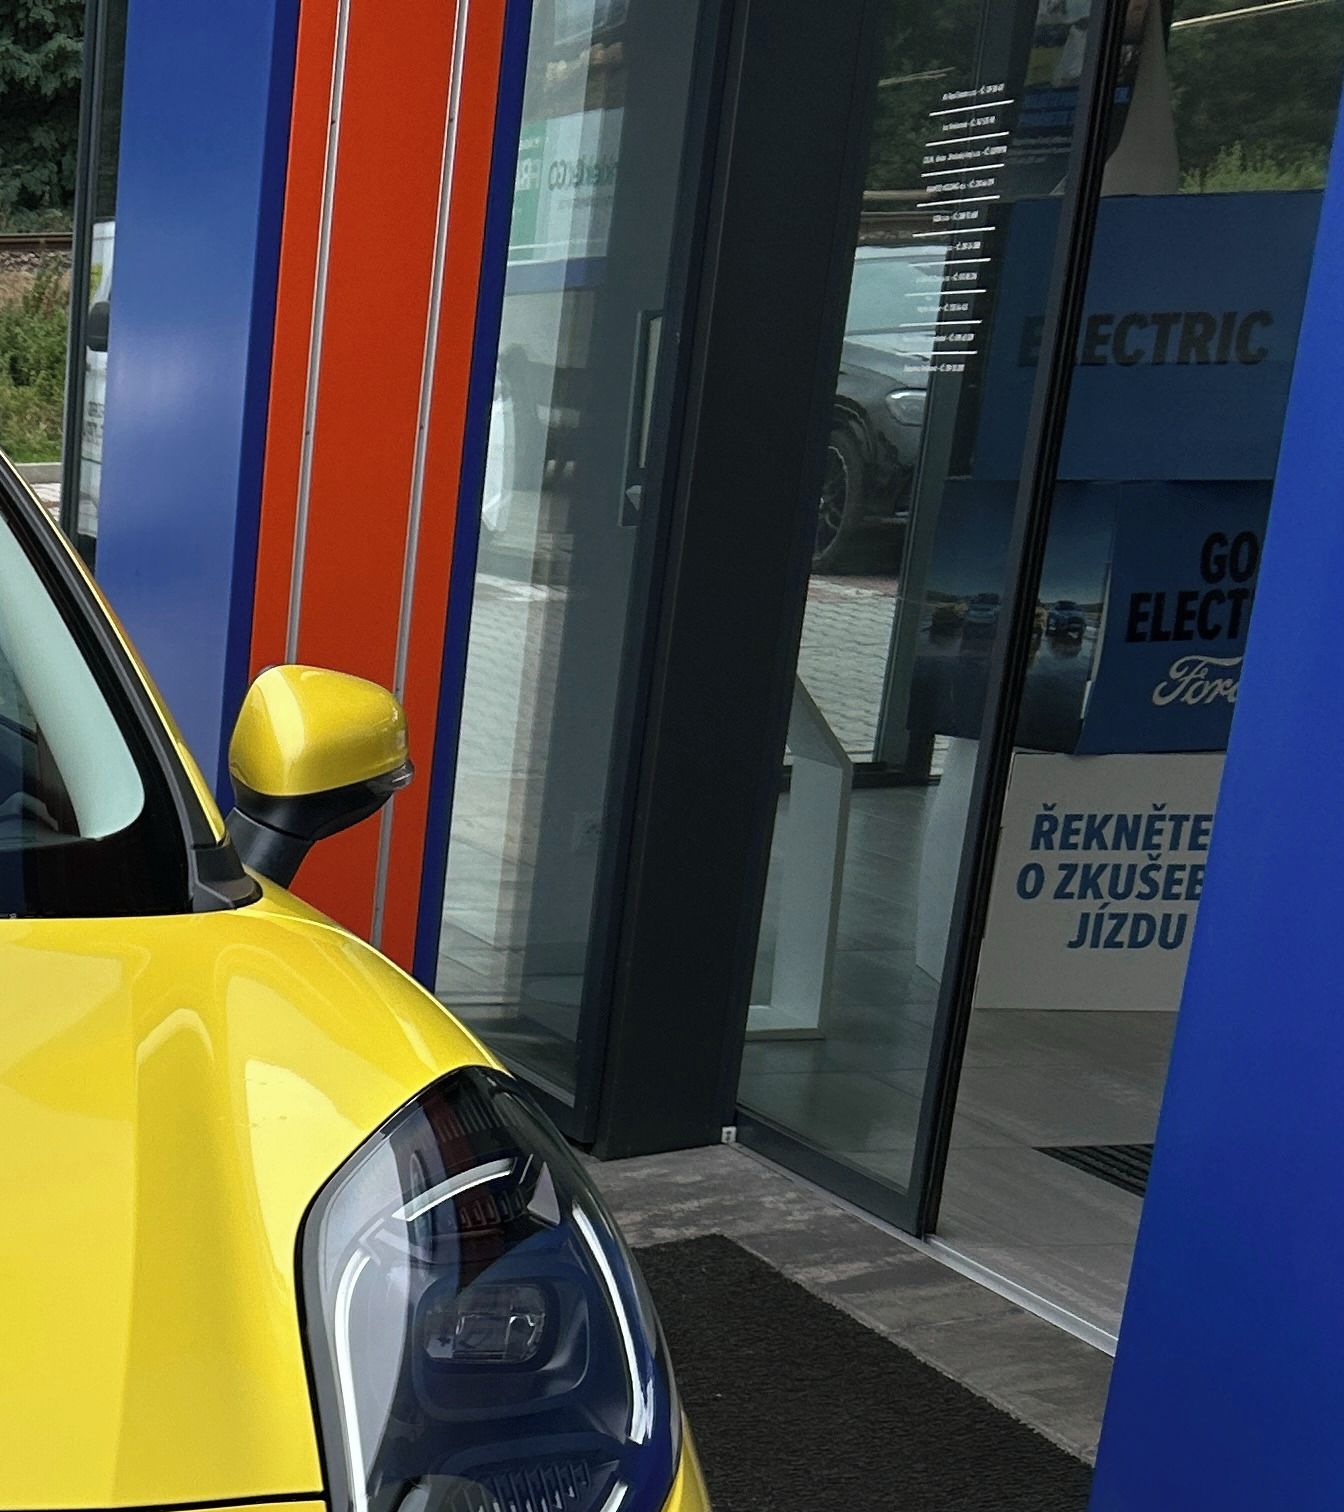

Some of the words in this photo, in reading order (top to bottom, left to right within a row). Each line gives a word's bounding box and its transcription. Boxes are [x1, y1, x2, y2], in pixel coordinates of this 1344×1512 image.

[1017, 309, 1275, 368] EECTRIC
[1199, 531, 1260, 584] GO
[1124, 586, 1256, 643] ELECT
[1029, 802, 1214, 851] ŘEKNĚTE
[1016, 862, 1045, 900] O
[1066, 901, 1188, 951] JÍZDU
